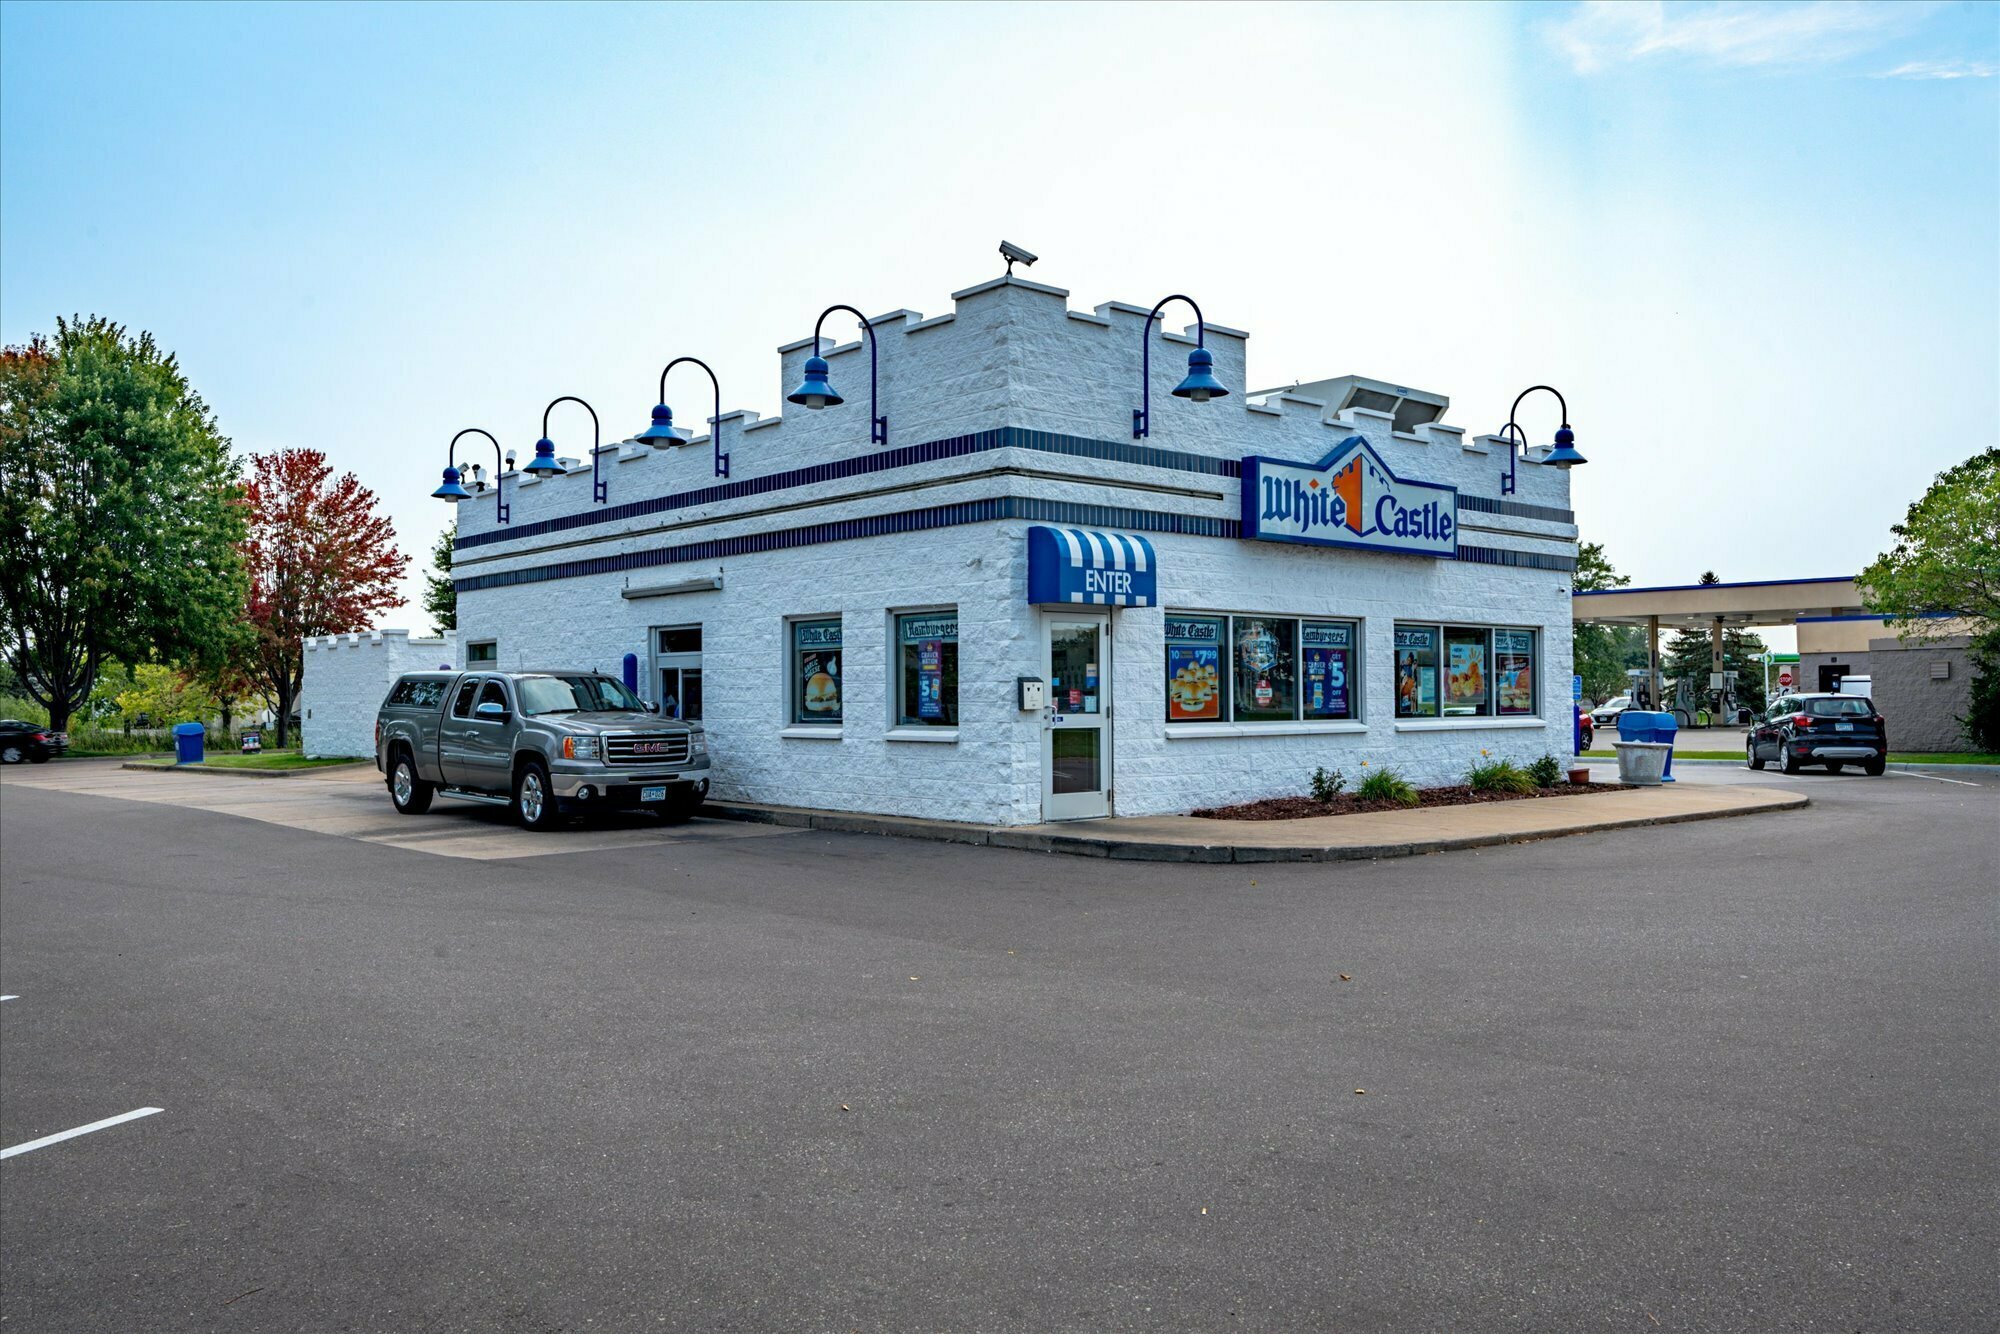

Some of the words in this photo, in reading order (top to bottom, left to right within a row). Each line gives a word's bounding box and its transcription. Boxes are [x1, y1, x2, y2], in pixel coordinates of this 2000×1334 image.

[1261, 476, 1346, 533] White
[1375, 494, 1452, 543] Castle
[1086, 569, 1132, 593] ENTER
[1188, 624, 1215, 638] Castle
[1409, 633, 1428, 645] Castle
[1171, 650, 1180, 659] 10
[634, 742, 668, 753] GMC
